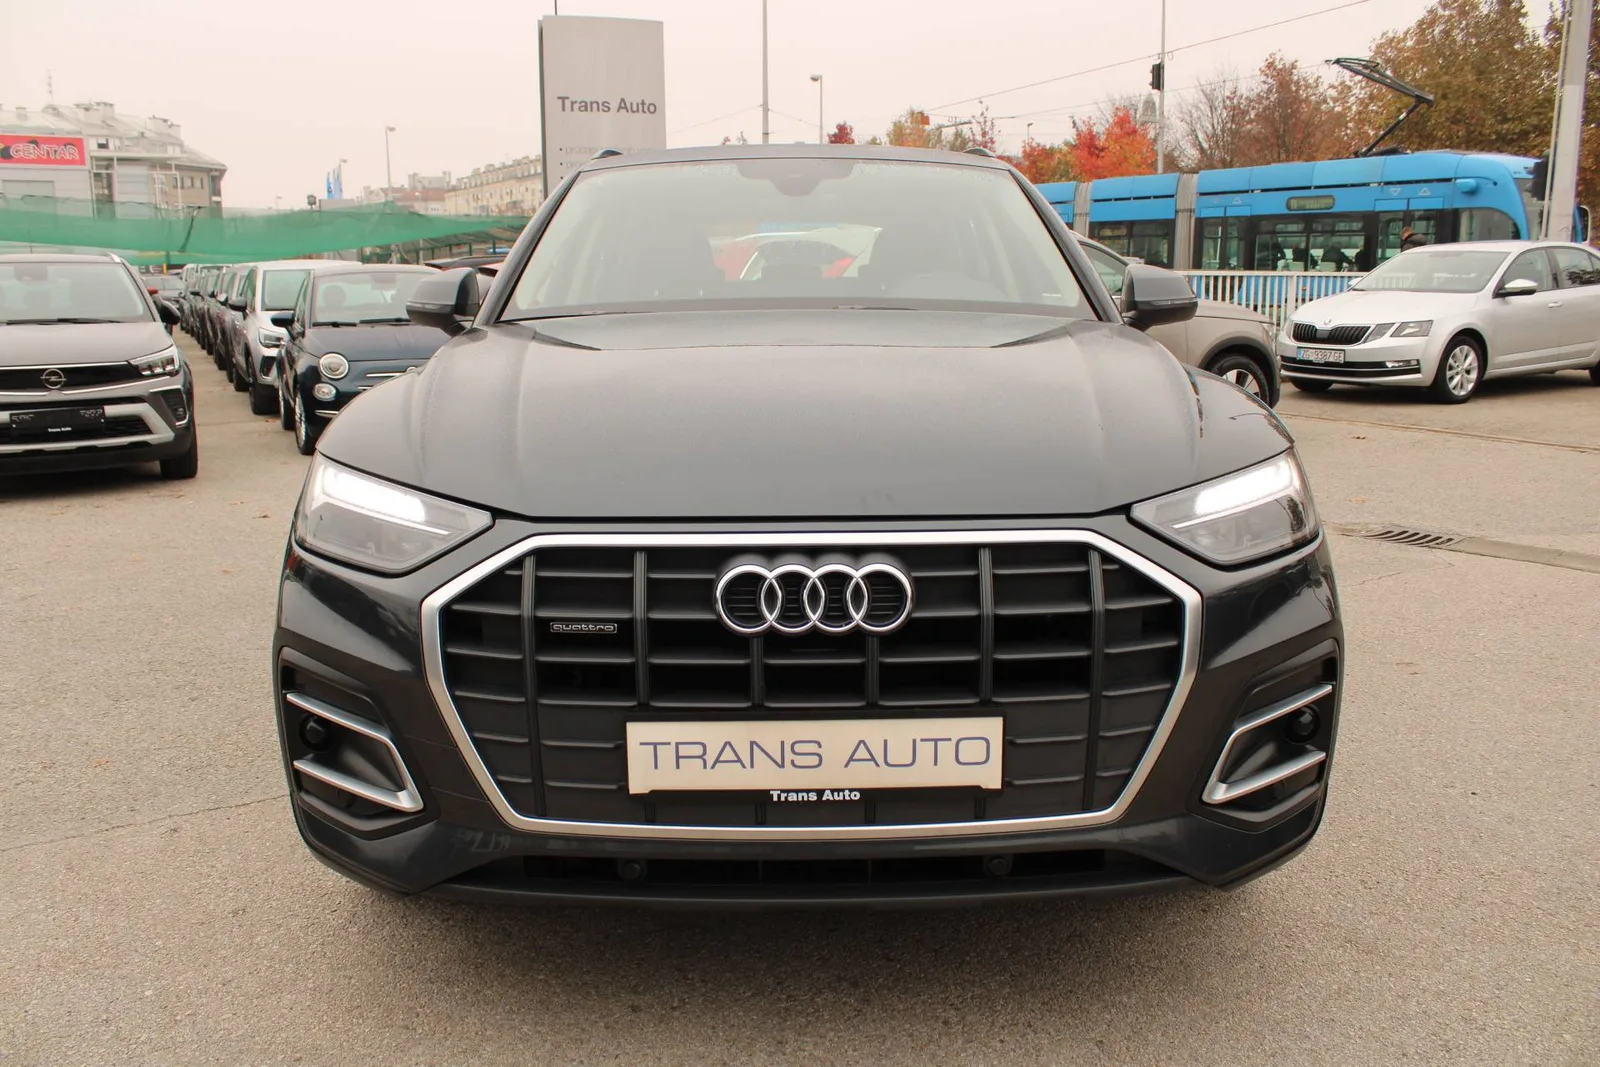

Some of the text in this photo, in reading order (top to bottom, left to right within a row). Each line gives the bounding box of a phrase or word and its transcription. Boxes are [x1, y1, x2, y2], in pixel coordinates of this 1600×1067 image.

[557, 96, 657, 114] Trans Auto
[10, 143, 80, 160] CENTAR
[552, 624, 614, 632] quattro
[639, 736, 991, 770] TRANS AUTO
[770, 789, 861, 802] Trans Auto
